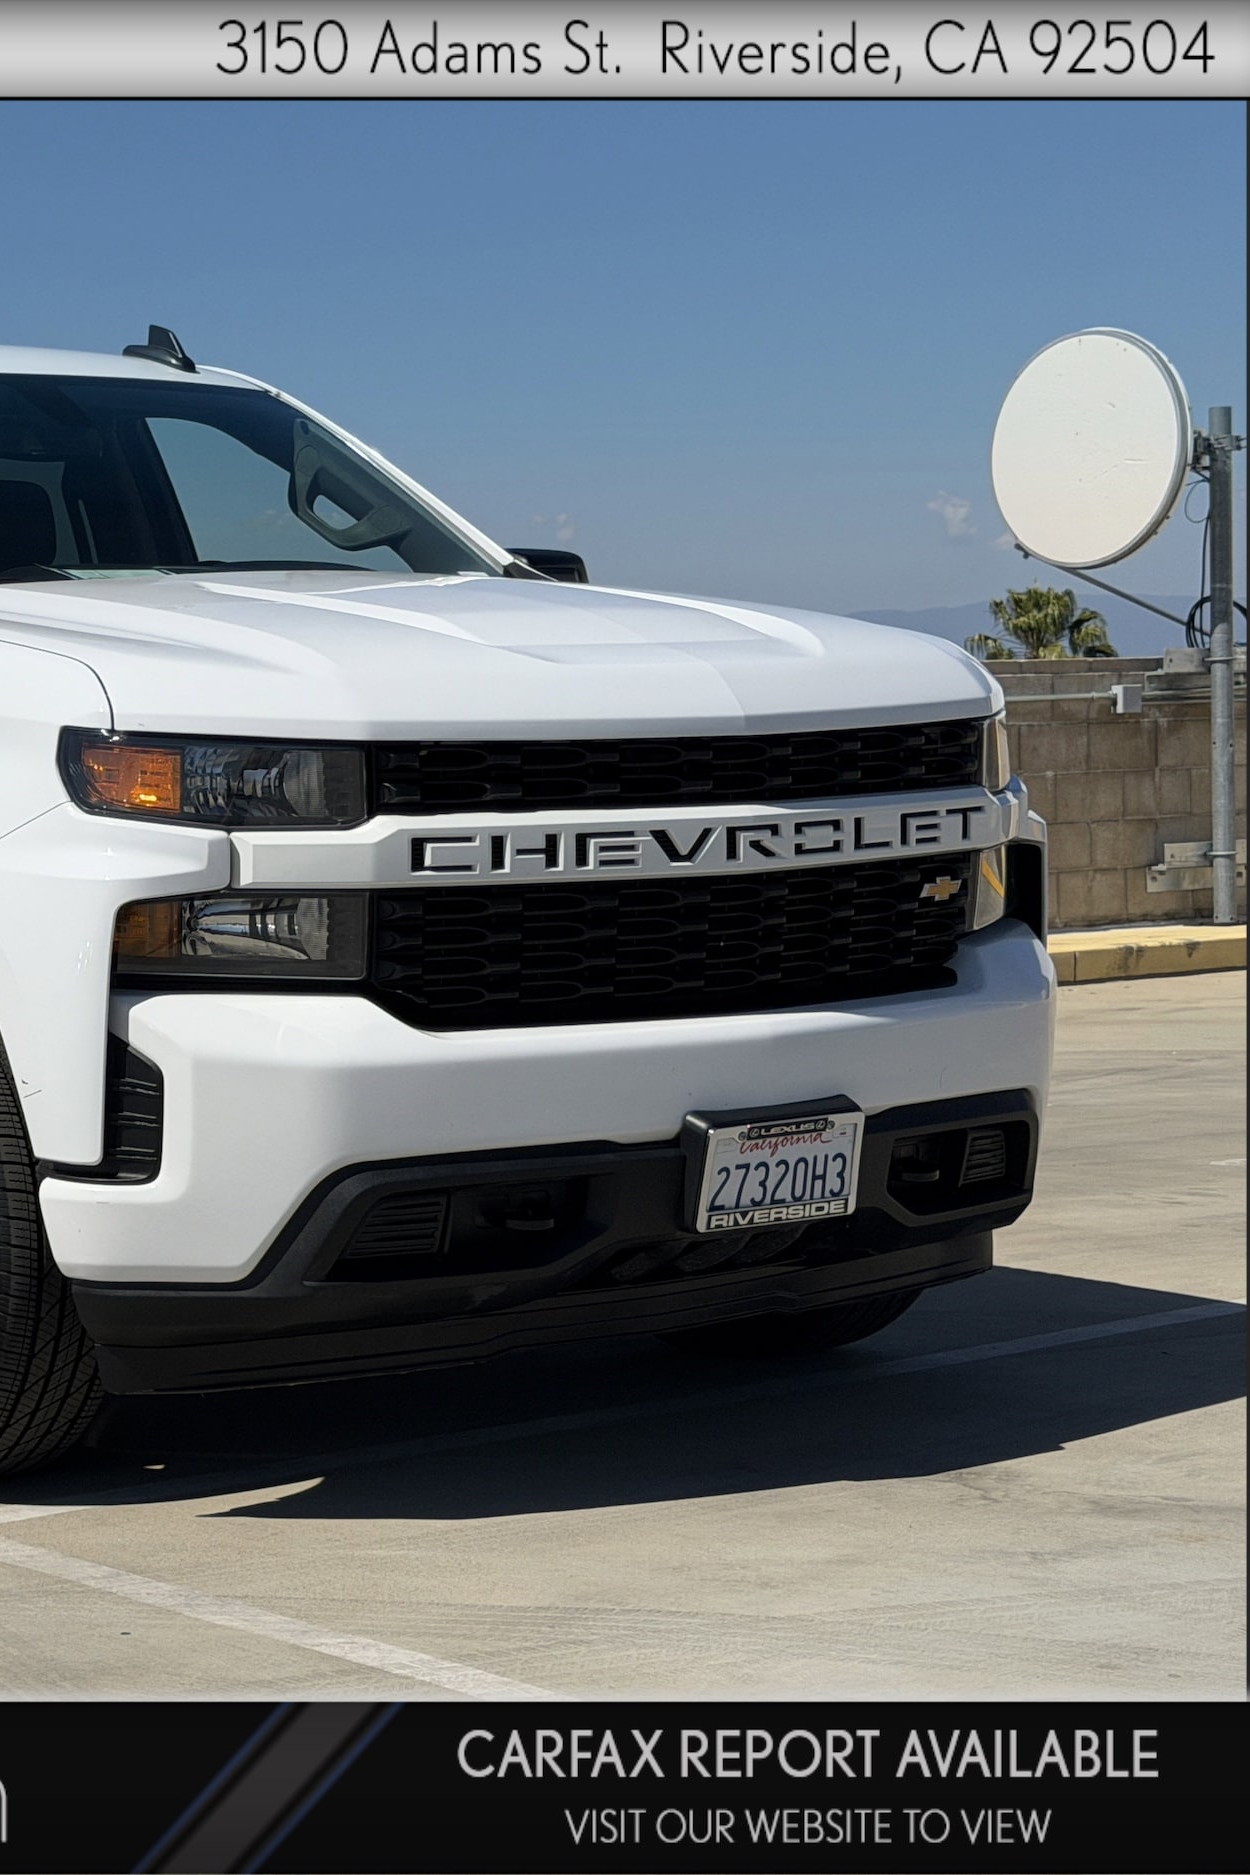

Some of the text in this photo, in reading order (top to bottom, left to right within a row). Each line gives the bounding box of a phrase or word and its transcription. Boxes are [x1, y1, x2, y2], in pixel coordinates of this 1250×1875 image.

[409, 805, 986, 874] CHEVROLET
[760, 1122, 815, 1136] LEXUS
[739, 1131, 832, 1158] California
[709, 1152, 847, 1211] 27320H3
[709, 1200, 845, 1228] RIVERSIDE
